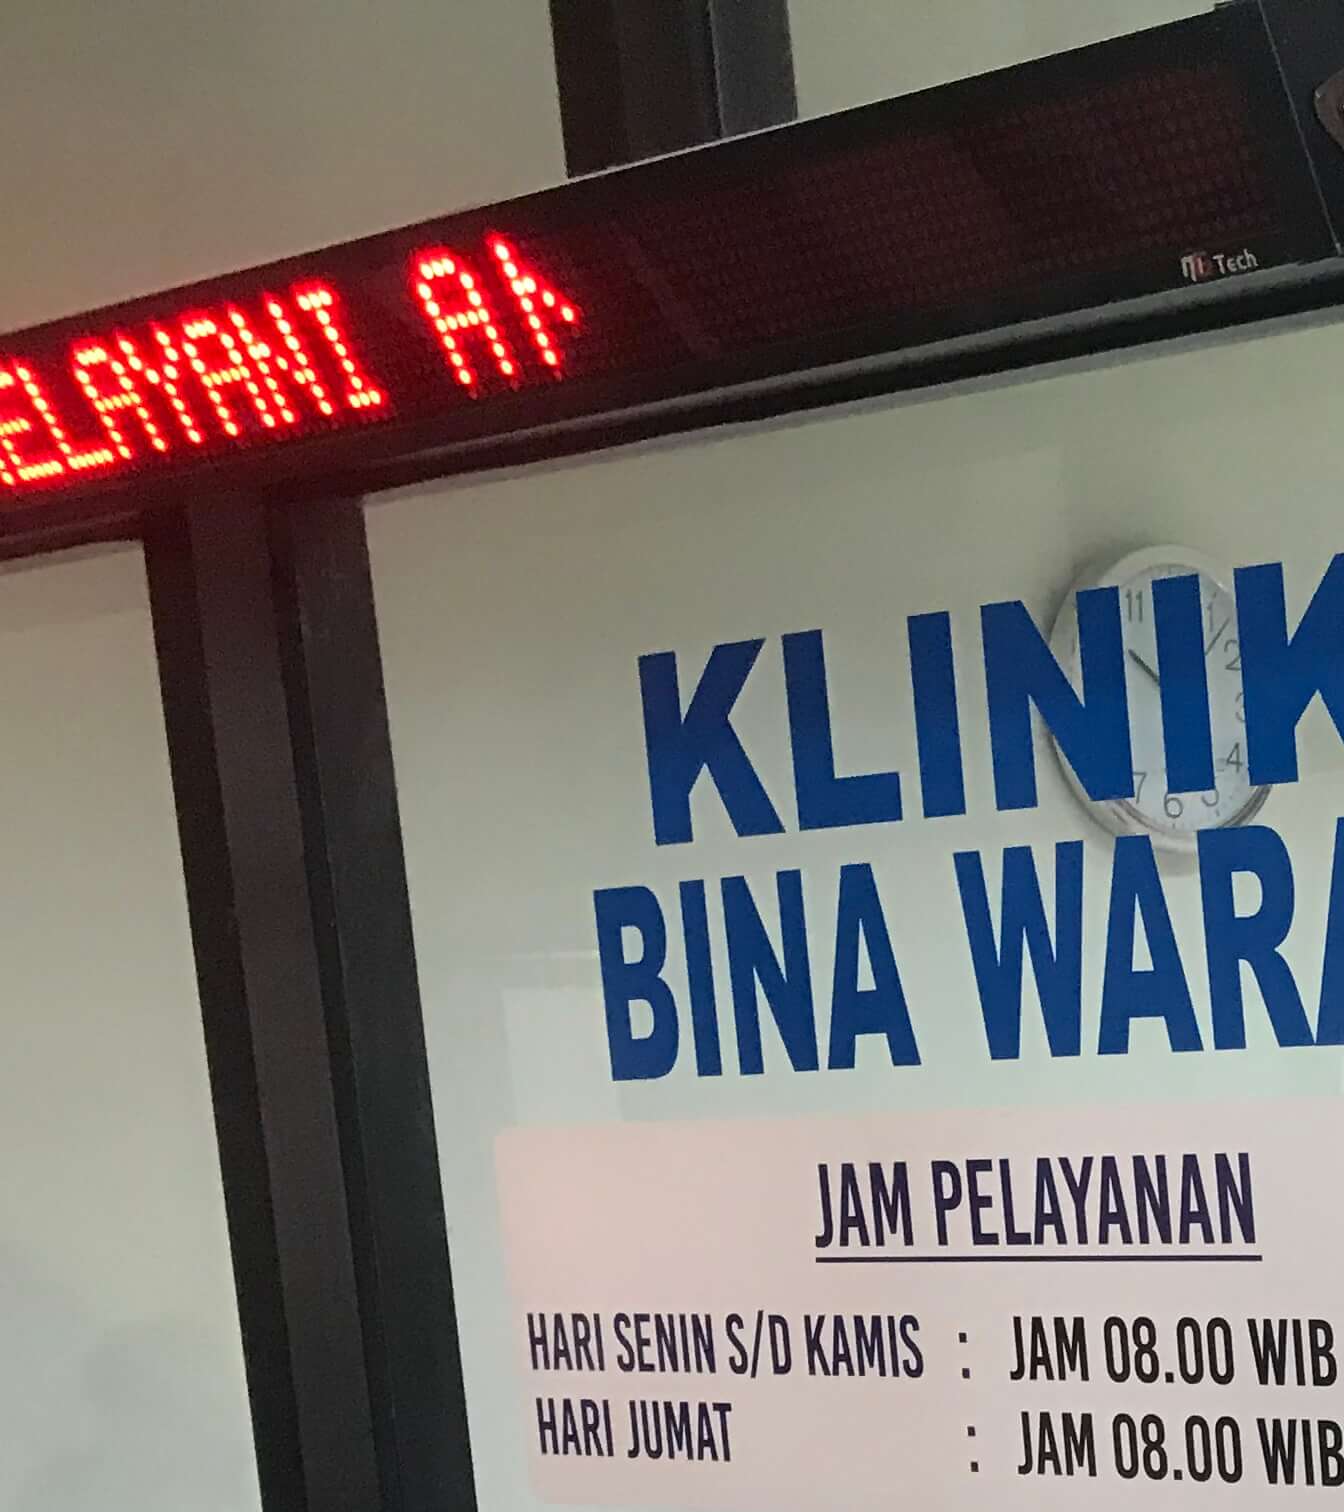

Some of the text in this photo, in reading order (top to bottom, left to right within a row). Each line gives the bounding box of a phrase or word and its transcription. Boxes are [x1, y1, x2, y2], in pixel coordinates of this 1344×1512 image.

[1212, 248, 1259, 275] Tech
[0, 283, 385, 487] ELAYANI
[593, 862, 921, 1081] BINA
[815, 1152, 1256, 1249] JAM PELAYANAN
[527, 1312, 604, 1372] HARI
[616, 1312, 717, 1375] SENIN
[728, 1310, 792, 1379] S/D
[804, 1314, 925, 1378] KAMIS
[1010, 1316, 1089, 1382] JAM
[1103, 1316, 1235, 1385] 08.00
[1247, 1318, 1338, 1387] WIB
[535, 1397, 615, 1457] HARI
[627, 1400, 732, 1462] JUMAT
[1017, 1411, 1097, 1478] JAM
[1111, 1412, 1243, 1484] 08.00
